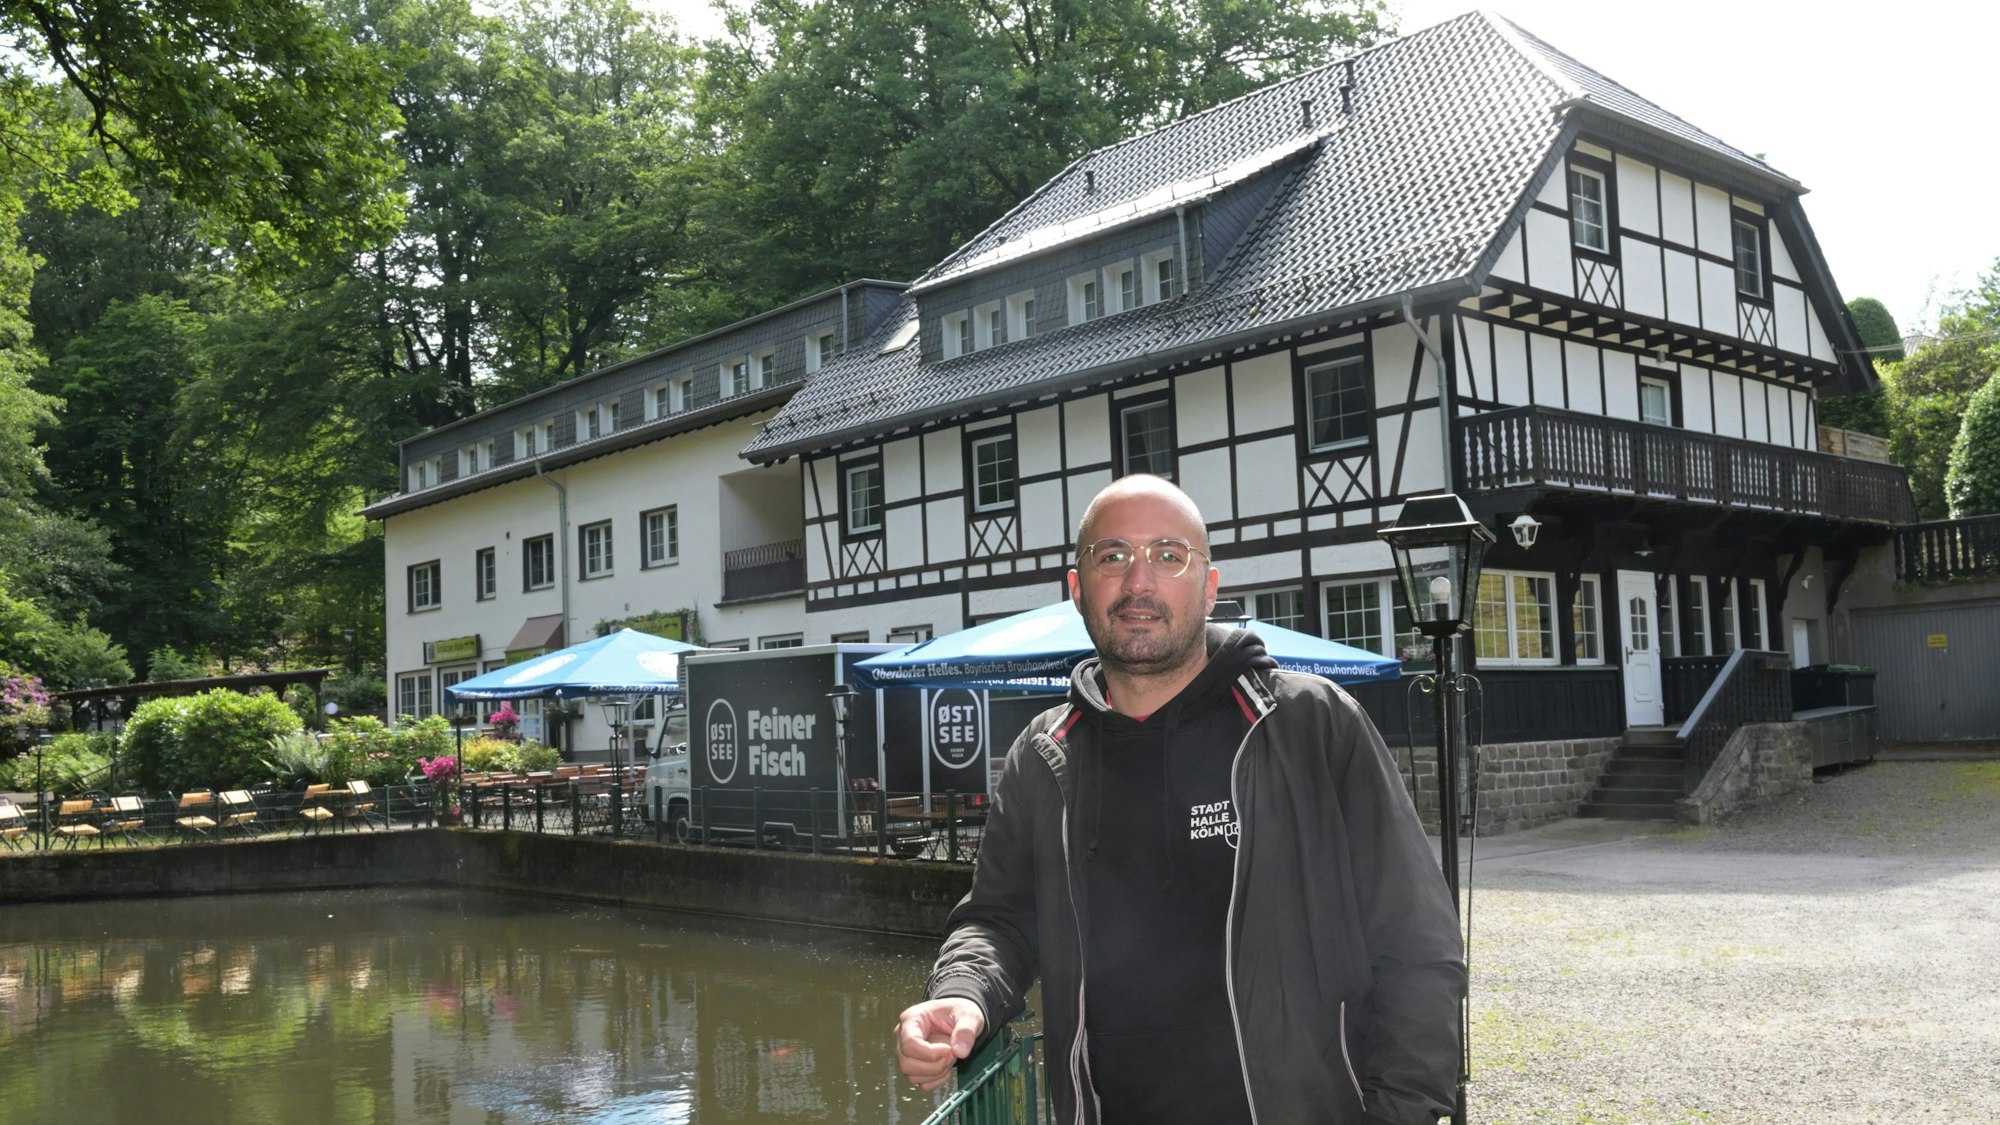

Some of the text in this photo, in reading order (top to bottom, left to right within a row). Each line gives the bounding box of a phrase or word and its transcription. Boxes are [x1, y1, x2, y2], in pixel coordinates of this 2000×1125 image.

[872, 664, 926, 680] Oberdorfer
[927, 662, 963, 677] Helles.
[747, 707, 816, 740] Feiner
[938, 704, 974, 725] ØST
[710, 722, 733, 742] ØST
[939, 725, 974, 744] SEE
[711, 743, 733, 760] SEE
[748, 743, 806, 777] Fisch
[1190, 800, 1230, 816] STADT
[1190, 812, 1230, 828] HALLE
[1190, 825, 1224, 840] KÖLN
